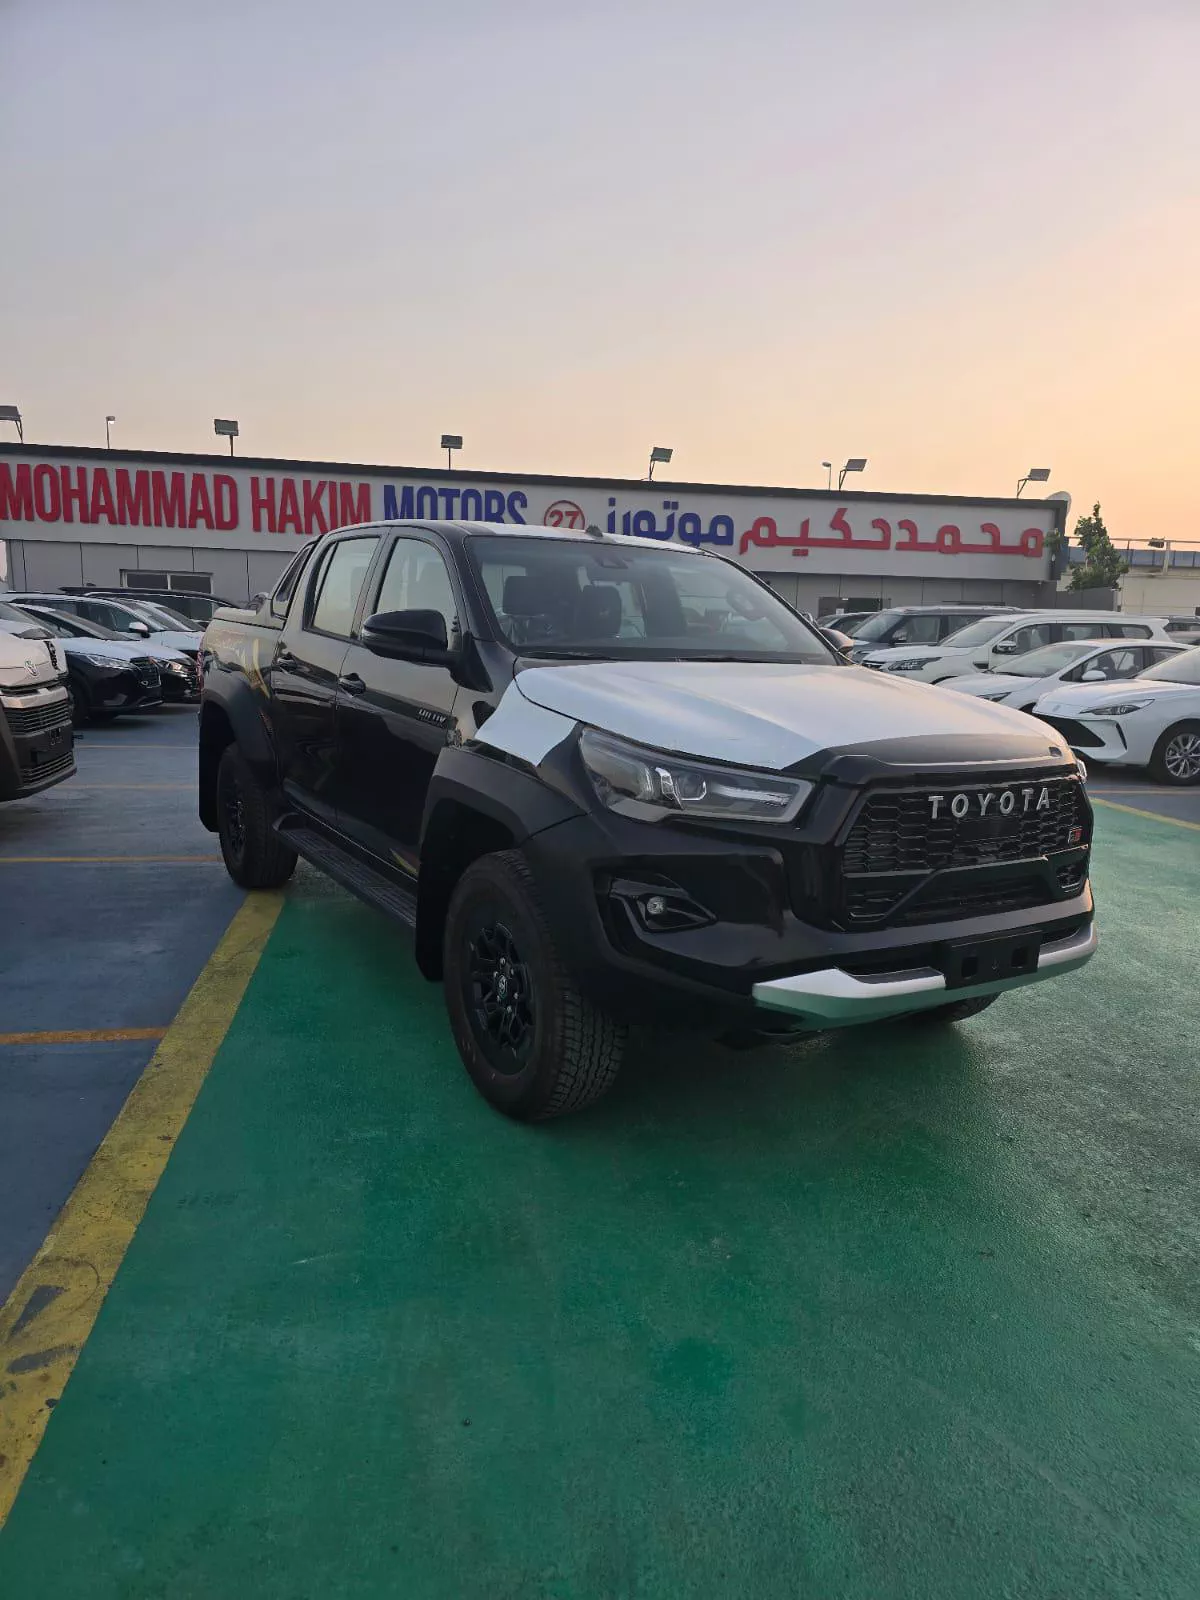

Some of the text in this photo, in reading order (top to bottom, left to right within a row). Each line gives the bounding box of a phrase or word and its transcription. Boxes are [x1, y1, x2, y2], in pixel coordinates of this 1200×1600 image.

[0, 462, 528, 535] MOHAMMAD HAKIM MOTORS
[549, 510, 580, 530] 27
[739, 507, 891, 557] حكيم
[895, 518, 1044, 558] محمد
[928, 787, 1050, 819] TOYOTA
